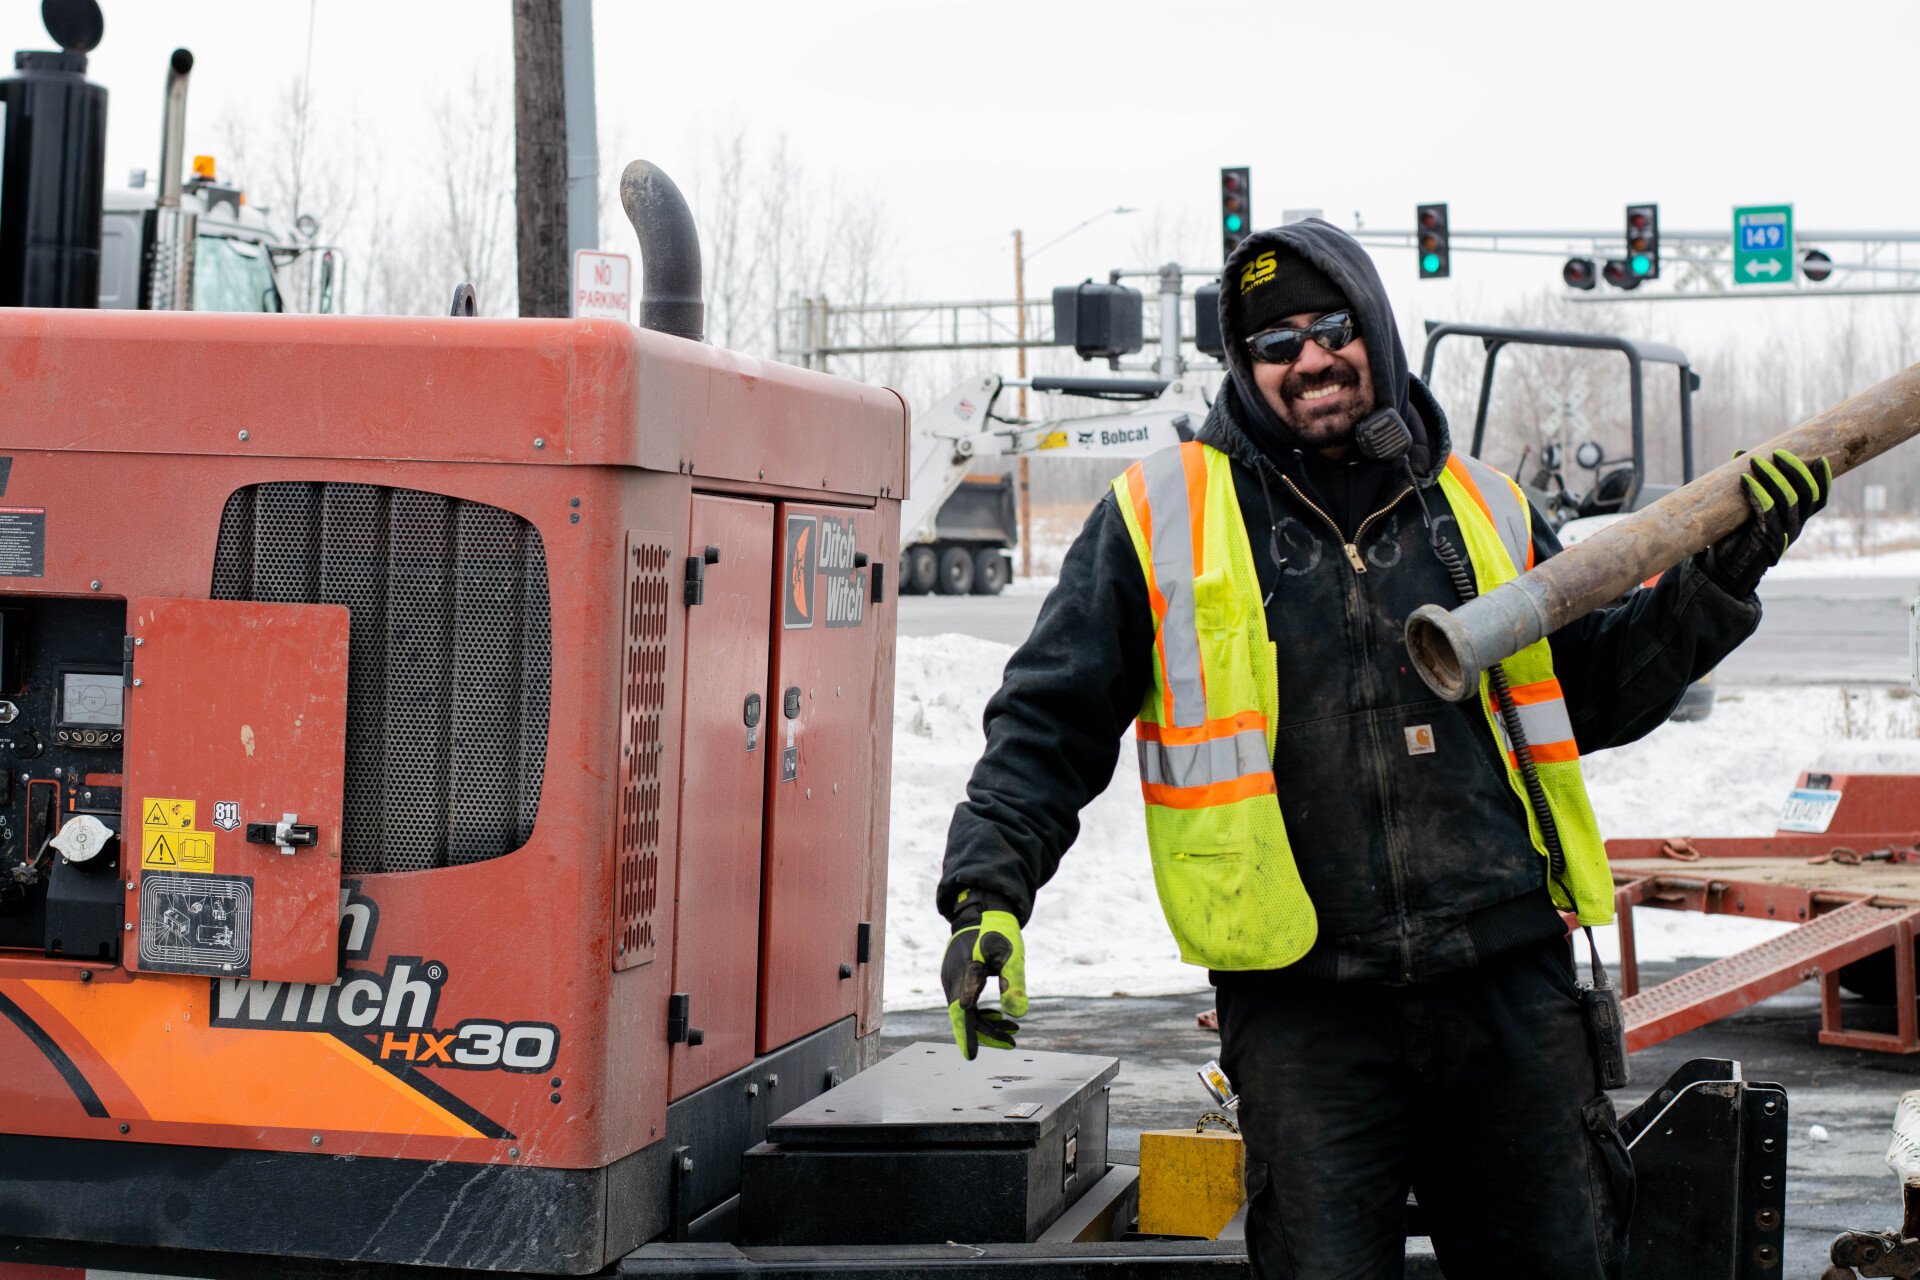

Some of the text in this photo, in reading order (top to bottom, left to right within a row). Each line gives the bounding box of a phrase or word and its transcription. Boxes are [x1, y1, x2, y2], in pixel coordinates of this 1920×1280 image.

[1746, 227, 1780, 247] 149
[595, 264, 611, 286] NO
[577, 288, 627, 310] PARKING
[1101, 426, 1148, 445] Bobcat
[819, 521, 856, 569] Ditch
[826, 576, 865, 622] Witch
[214, 802, 240, 821] 811
[380, 1024, 556, 1069] HX30
